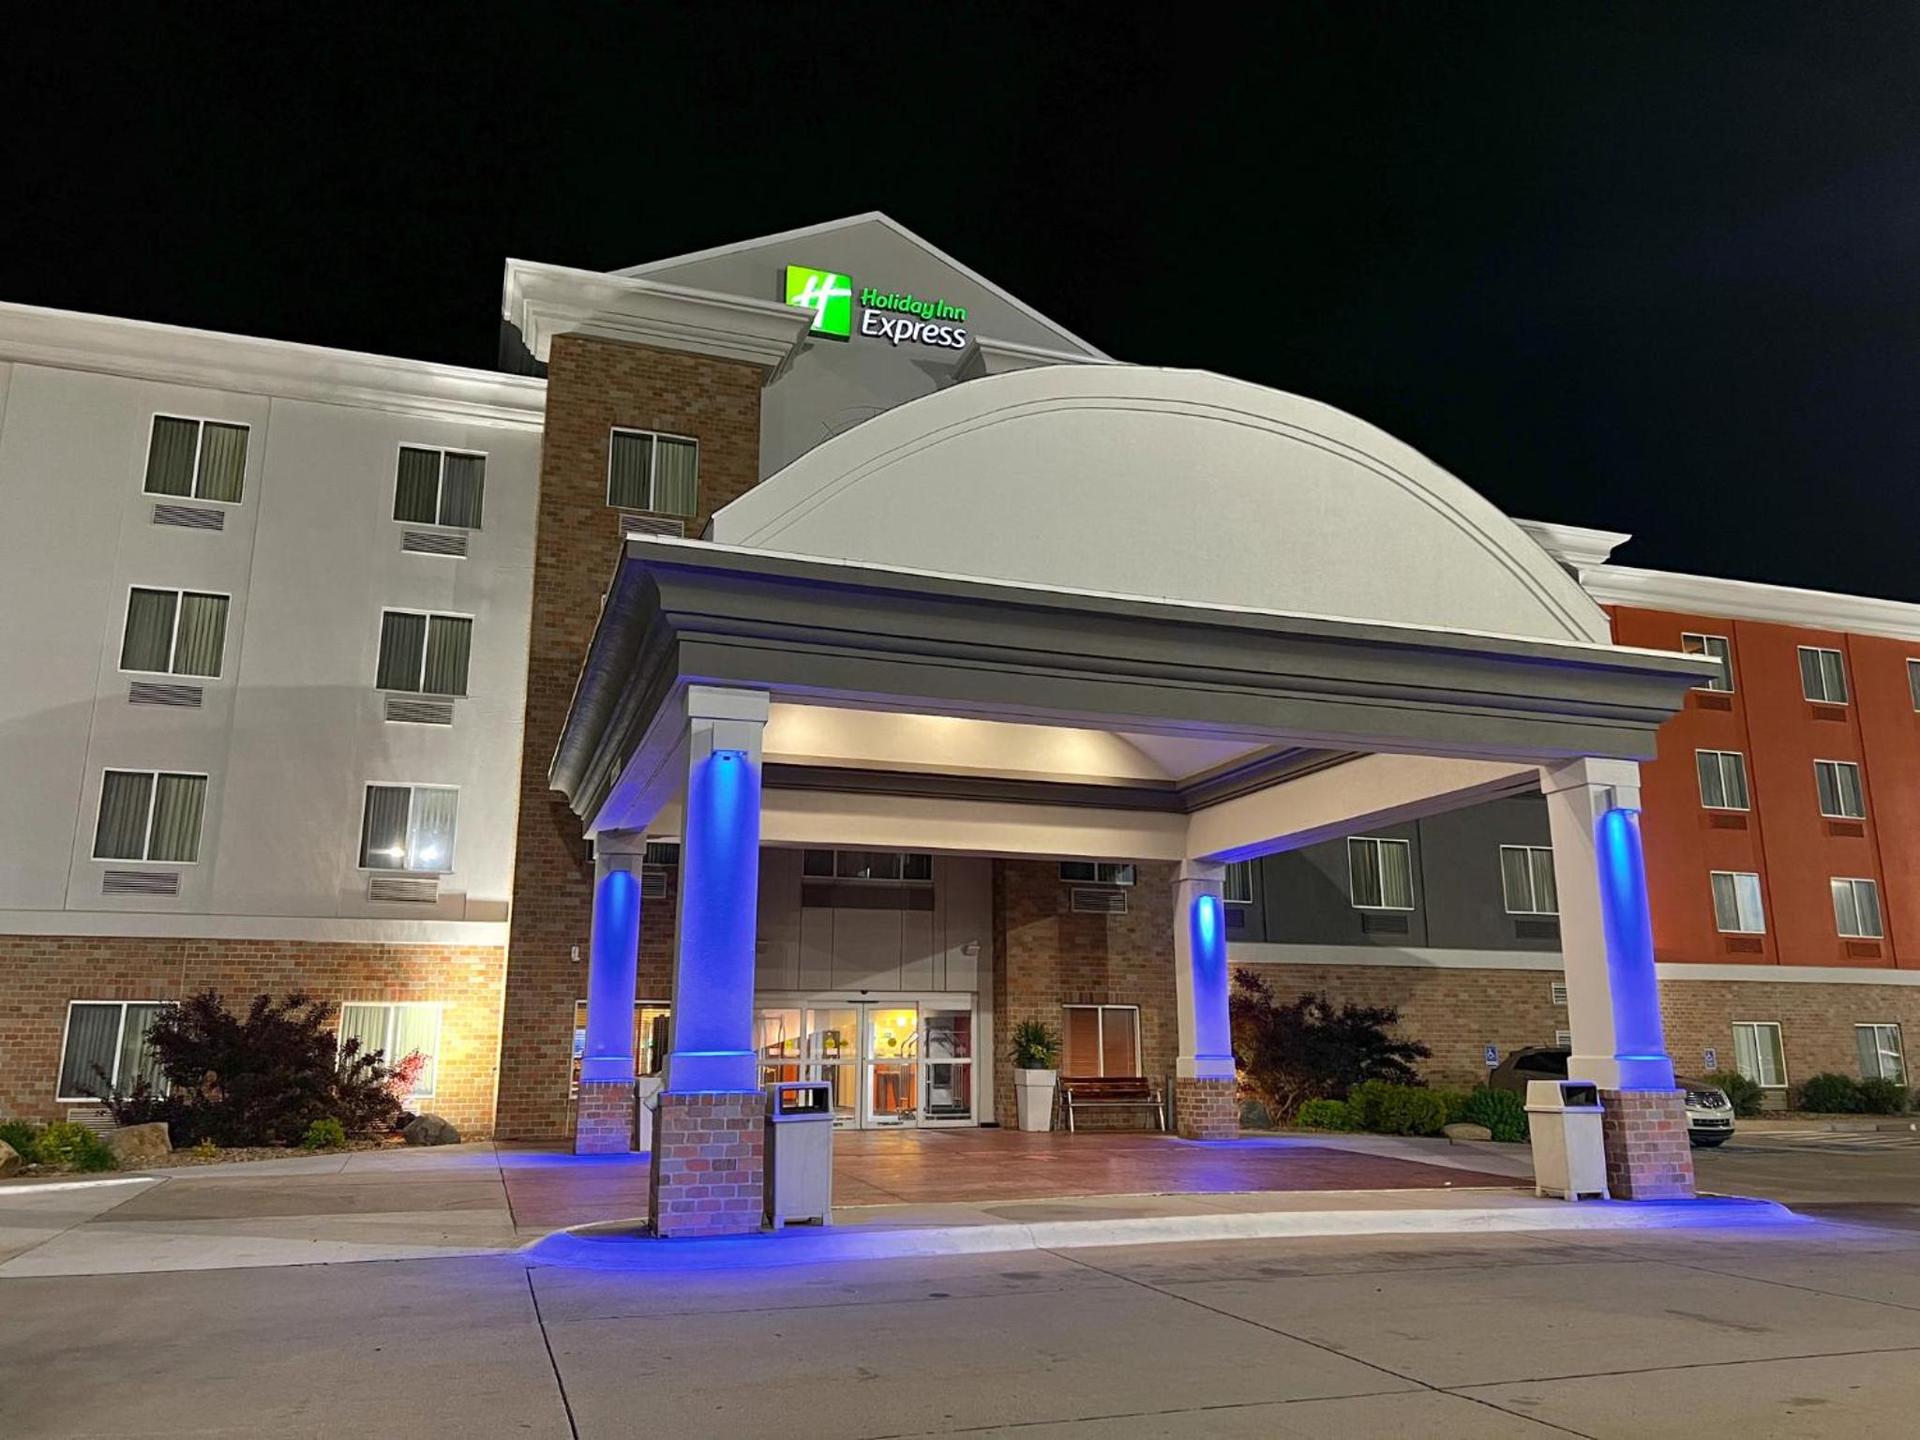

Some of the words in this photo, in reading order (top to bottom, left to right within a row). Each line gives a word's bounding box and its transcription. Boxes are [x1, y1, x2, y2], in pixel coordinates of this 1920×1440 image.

[860, 287, 935, 319] Holiday
[936, 299, 968, 321] Inn
[861, 308, 967, 348] Express
